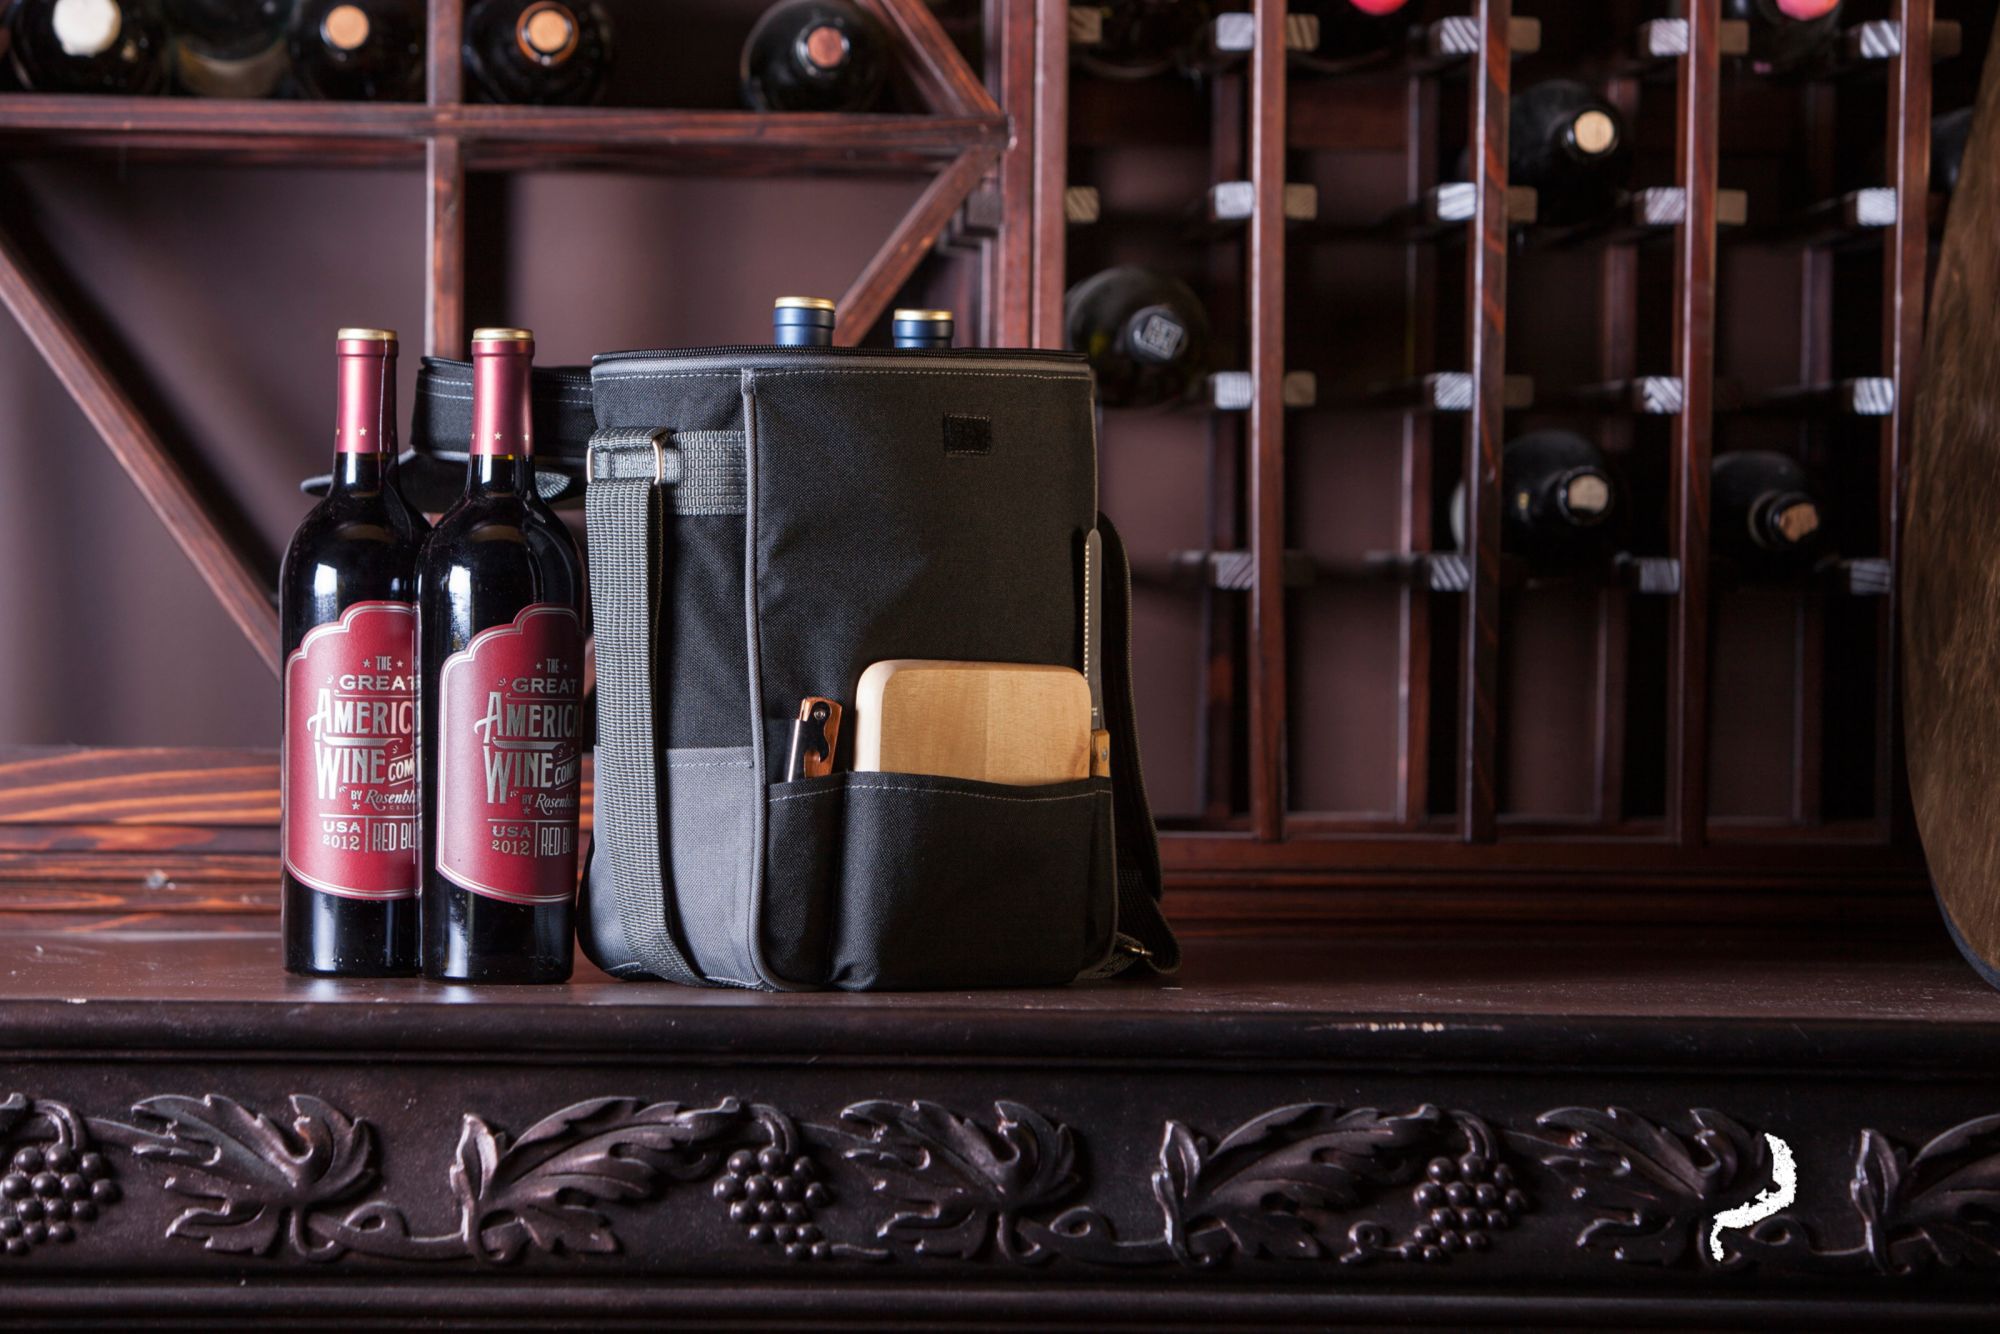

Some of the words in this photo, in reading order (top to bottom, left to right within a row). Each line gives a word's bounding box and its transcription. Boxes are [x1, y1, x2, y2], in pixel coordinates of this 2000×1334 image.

[376, 656, 392, 671] THE
[546, 658, 560, 674] THE
[511, 677, 577, 694] GREAT
[307, 687, 413, 741] AMERIC
[314, 741, 386, 800] WINE
[388, 757, 414, 782] COM
[483, 745, 554, 804] WINE
[351, 790, 363, 800] BY
[364, 788, 416, 811] Rosenbl
[522, 794, 533, 804] BY
[323, 821, 361, 834] USA
[492, 825, 531, 838] USA
[322, 834, 360, 851] 2012
[372, 822, 397, 851] RED
[400, 822, 415, 850] BL
[541, 827, 560, 856] RED
[562, 826, 574, 854] BL
[492, 839, 529, 856] 2012
